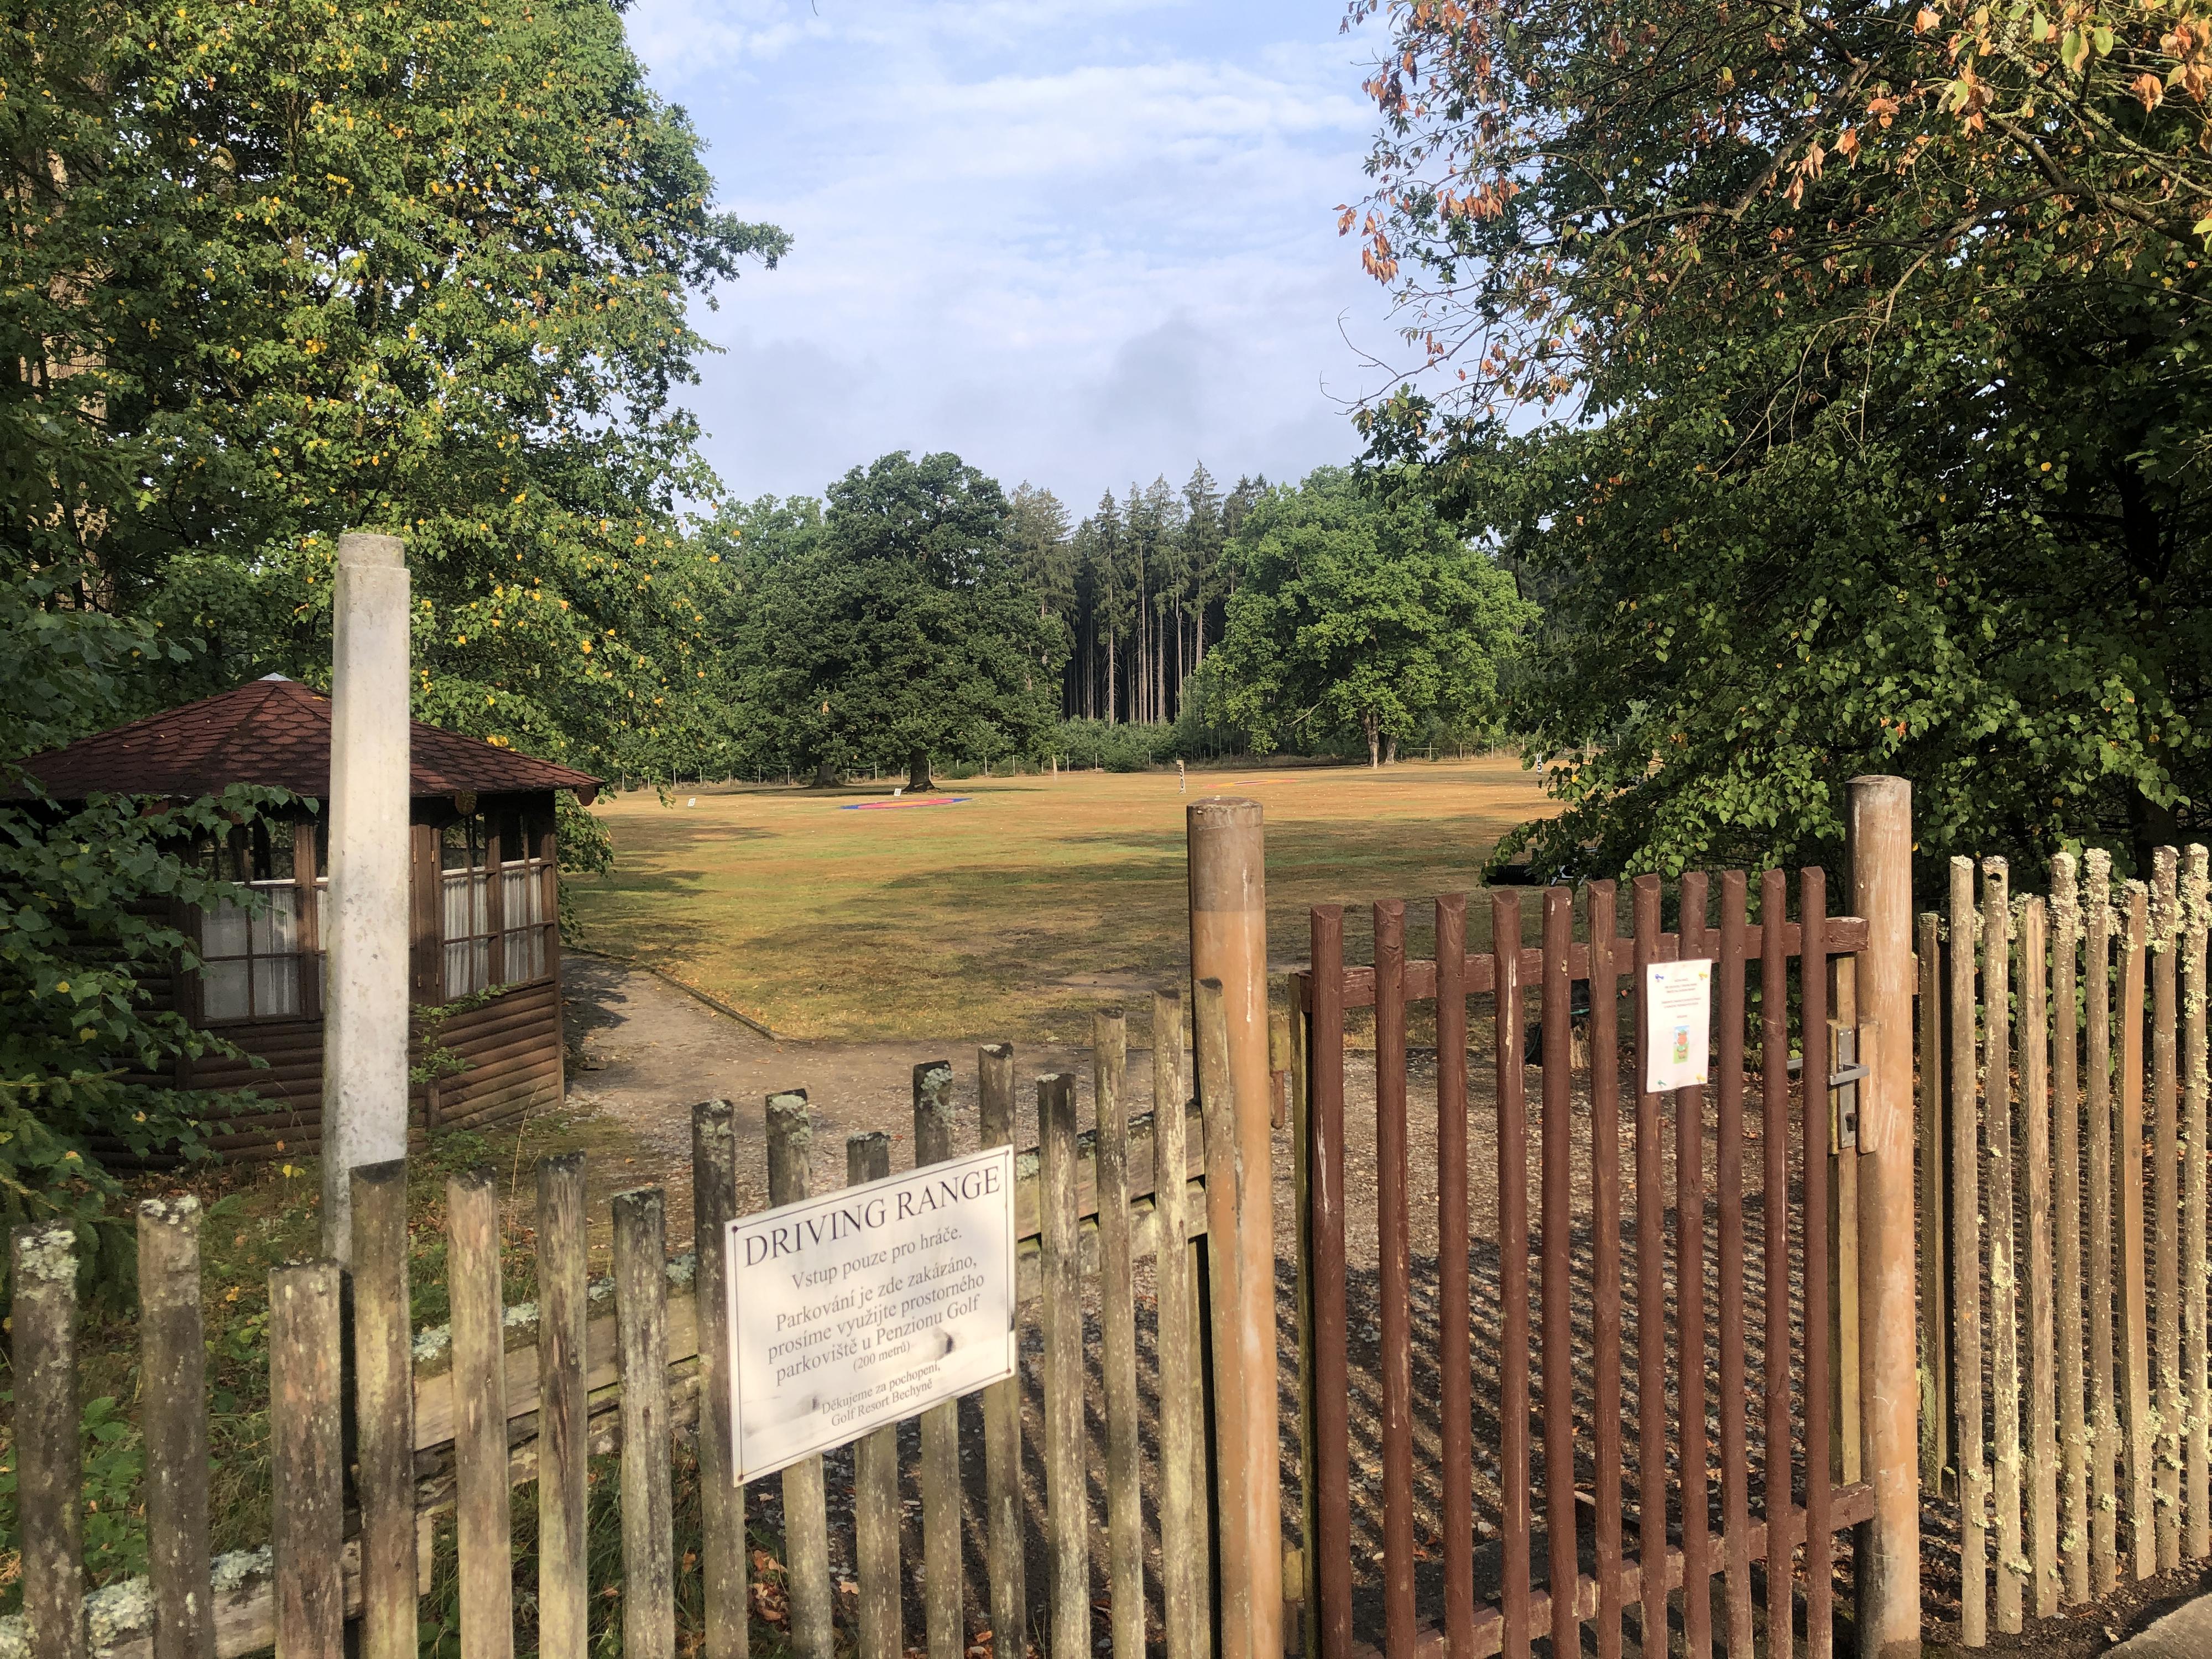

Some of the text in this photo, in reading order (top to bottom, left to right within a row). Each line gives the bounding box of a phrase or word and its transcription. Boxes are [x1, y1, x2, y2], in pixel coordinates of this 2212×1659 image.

[743, 1166, 1001, 1268] DRIVING RANGE
[791, 1225, 962, 1290] Vstup pouze pro hráče.
[768, 1274, 984, 1365] prosíme využijte prostorného
[775, 1256, 977, 1333] Parkování je zde zakázáno,
[775, 1293, 980, 1387] parkoviště u Penzionu Golf
[853, 1340, 911, 1373] (200 metrů)
[822, 1360, 941, 1415] Děkujeme za pochopení,
[831, 1378, 933, 1427] Golf Resort Bechyně
